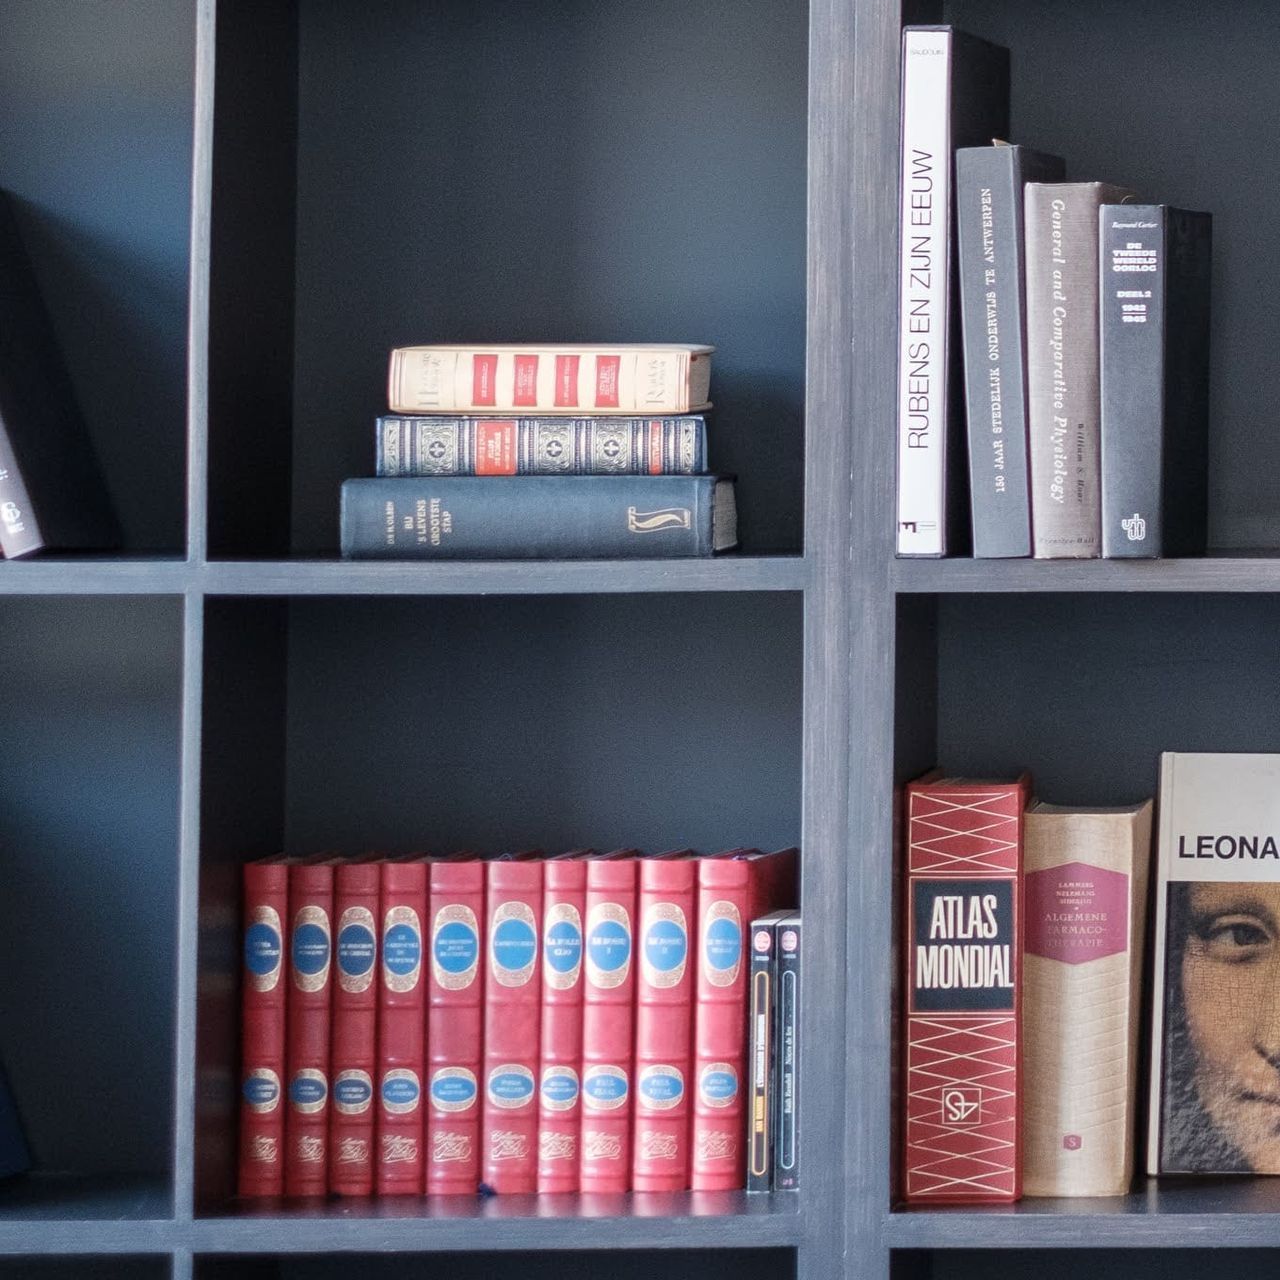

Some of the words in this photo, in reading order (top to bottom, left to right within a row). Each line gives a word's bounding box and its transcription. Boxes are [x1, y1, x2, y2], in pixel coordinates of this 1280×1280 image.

[911, 149, 932, 224] EEUW
[981, 188, 995, 262] ANTWERPEN
[1051, 199, 1065, 263] General
[910, 236, 931, 288] ZIJN
[985, 268, 995, 284] TE
[1052, 270, 1065, 300] and
[909, 299, 930, 332] EN
[986, 291, 999, 359] ONDERWIJS
[1049, 306, 1066, 408] Comparative
[907, 342, 930, 448] RUBENS
[990, 367, 1002, 433] STEDELIJK
[993, 440, 1004, 469] JAAR
[1049, 415, 1067, 503] Physiology
[994, 475, 1005, 492] 150
[417, 499, 426, 534] LEVENS
[443, 511, 451, 533] STAP
[931, 895, 997, 939] ATLAS
[1045, 913, 1107, 921] ALGEMENE
[916, 944, 1014, 989] MONDIAL
